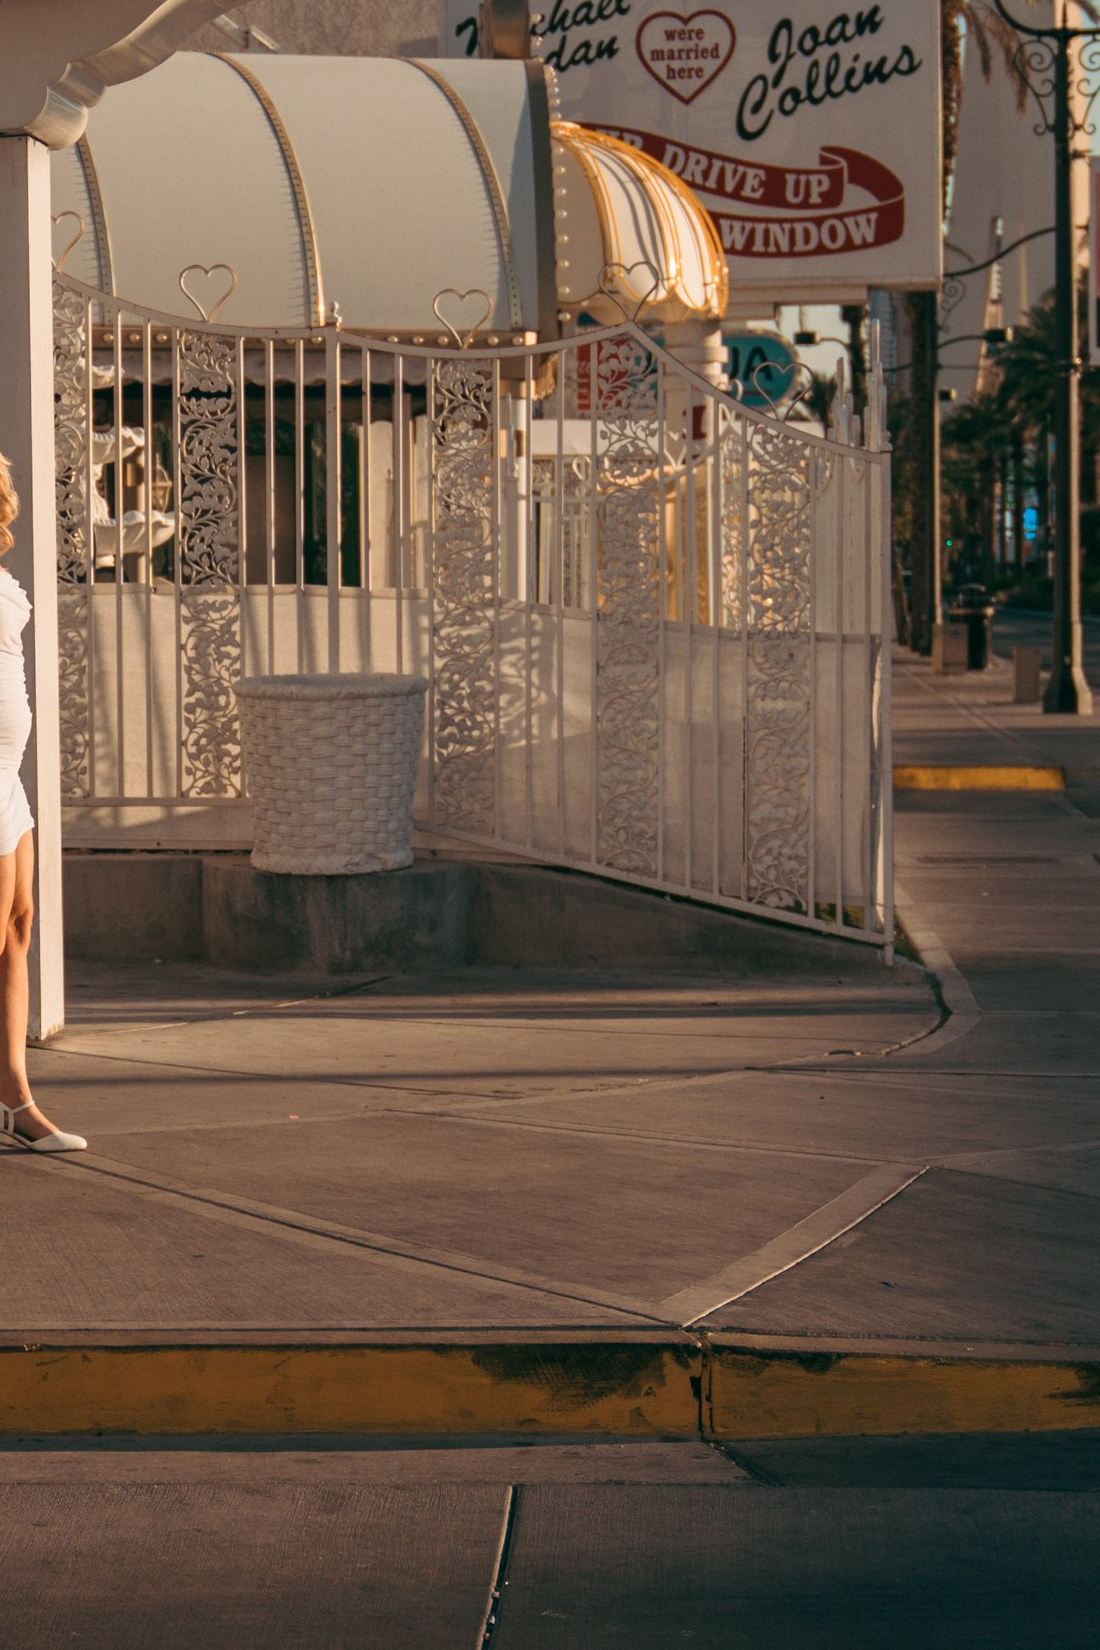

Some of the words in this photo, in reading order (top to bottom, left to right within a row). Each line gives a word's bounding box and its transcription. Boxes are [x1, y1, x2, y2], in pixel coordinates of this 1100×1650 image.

[650, 43, 720, 62] married
[663, 27, 705, 43] were
[767, 4, 885, 89] Joan
[666, 64, 705, 80] here
[735, 44, 923, 142] Collins
[662, 144, 767, 199] DRIVE
[785, 173, 831, 204] UP
[719, 211, 879, 252] WINDOW
